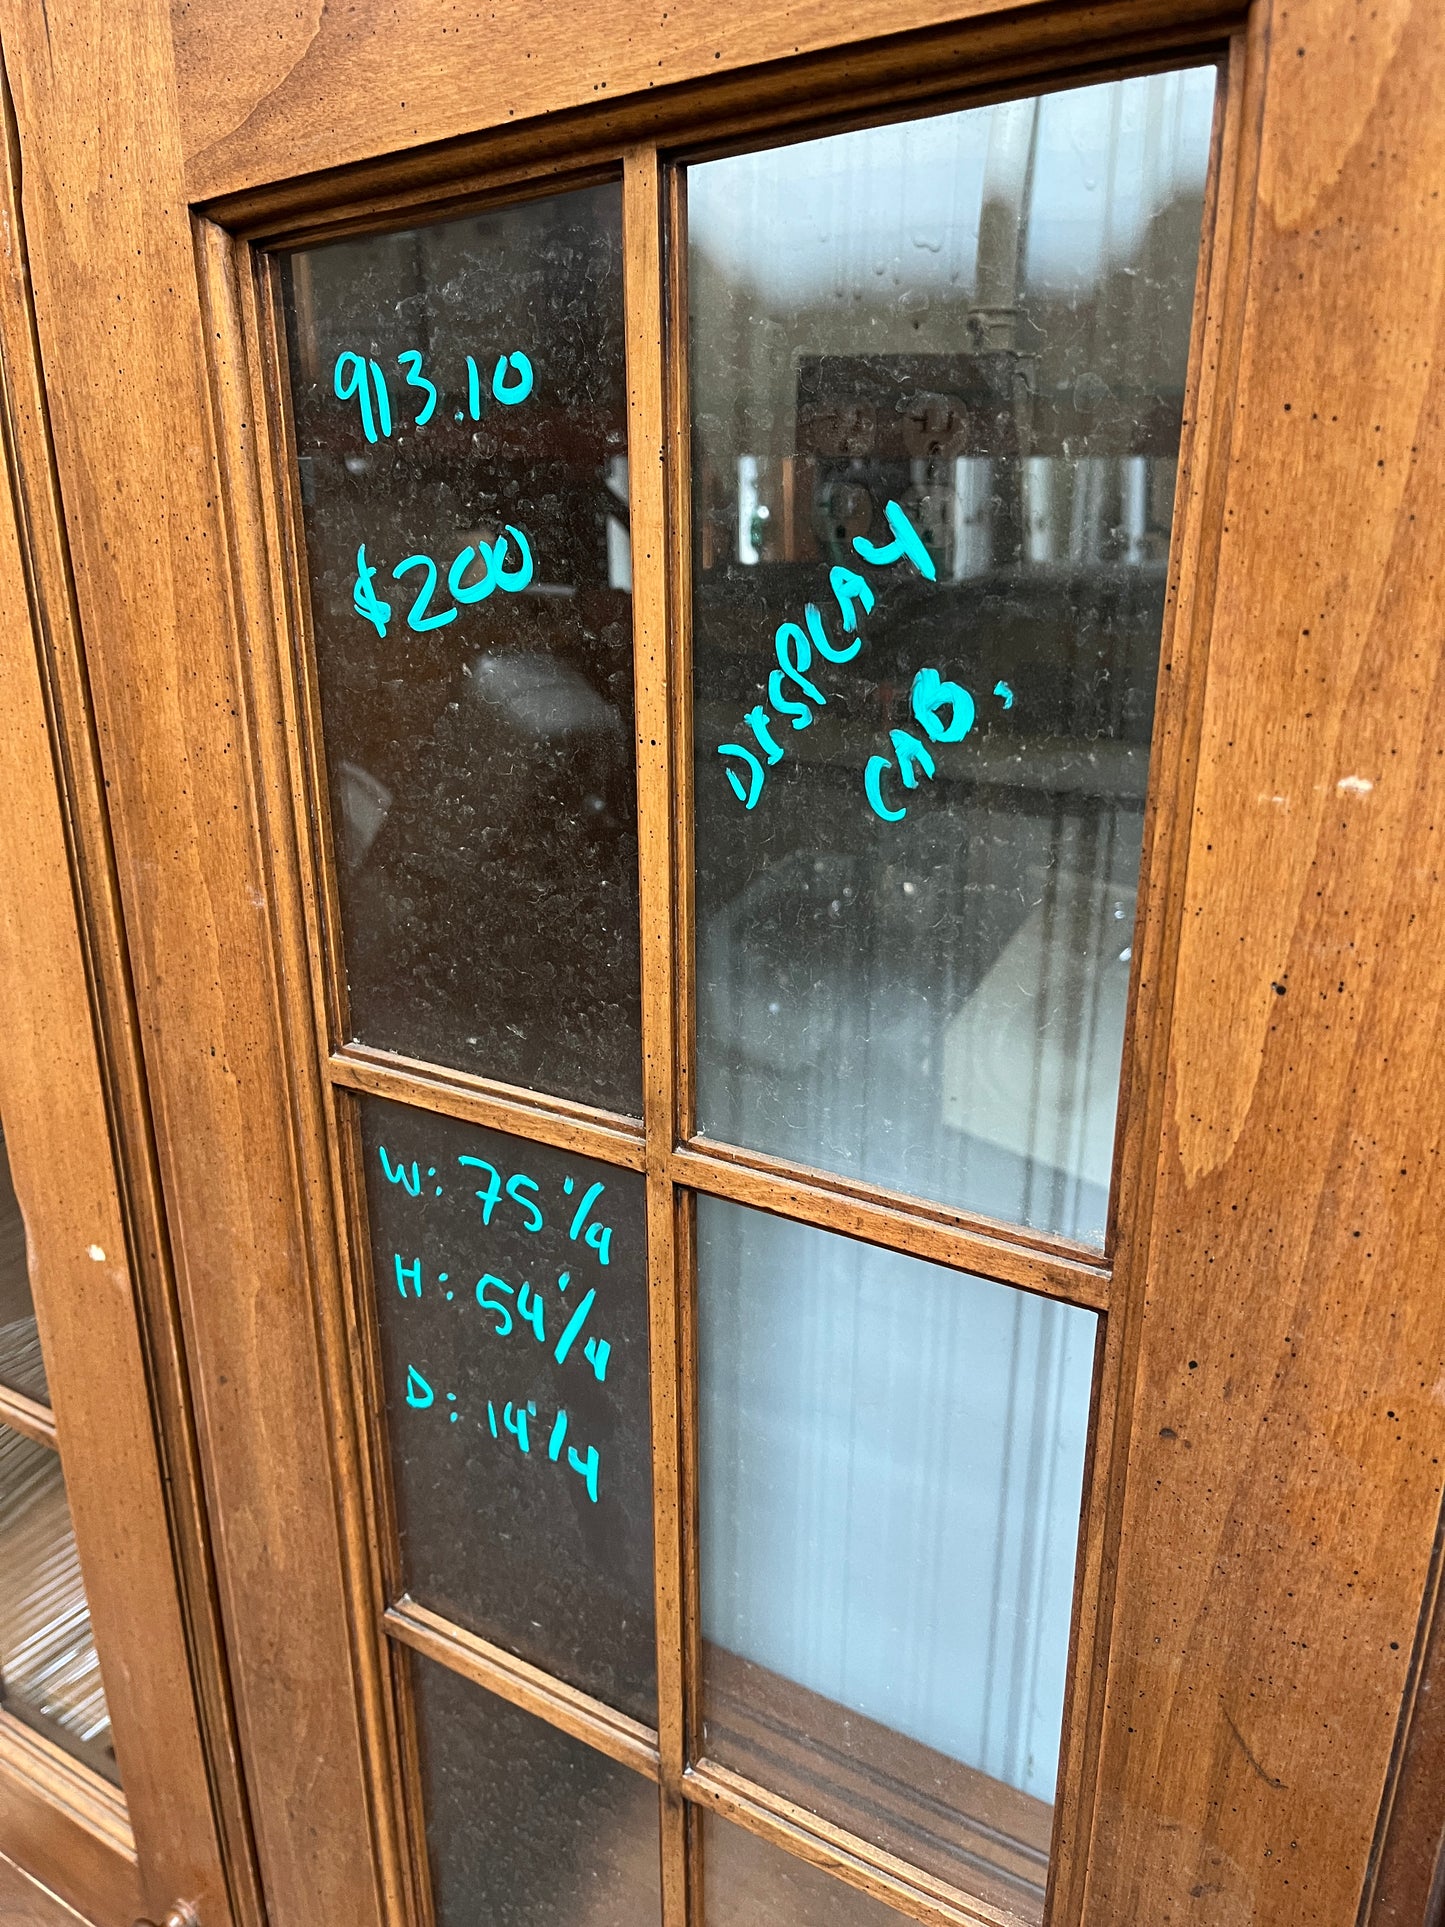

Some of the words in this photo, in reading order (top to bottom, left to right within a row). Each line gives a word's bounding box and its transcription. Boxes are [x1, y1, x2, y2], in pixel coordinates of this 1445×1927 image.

[334, 350, 534, 444] 913.10
[353, 524, 534, 638] $200
[717, 500, 937, 810] DISPLAY
[378, 1146, 443, 1197] W:
[458, 1155, 543, 1233] 75
[394, 1253, 454, 1300] H:
[476, 1273, 546, 1343] 54
[405, 1364, 459, 1423] D:
